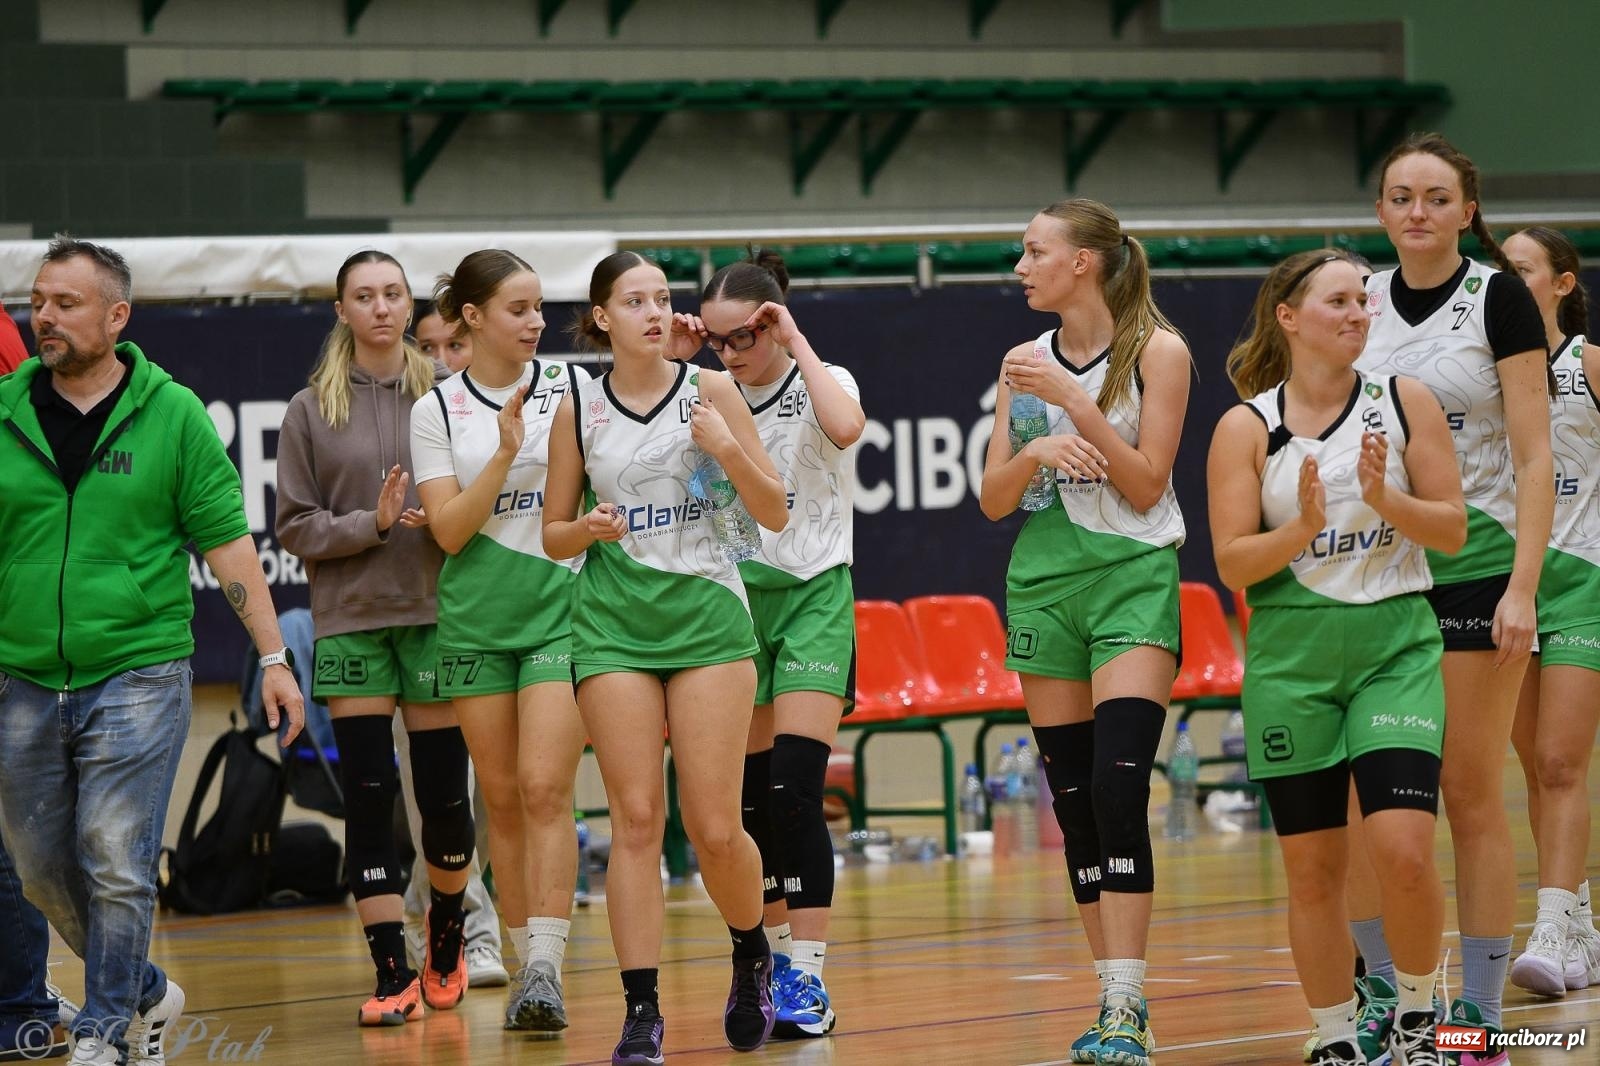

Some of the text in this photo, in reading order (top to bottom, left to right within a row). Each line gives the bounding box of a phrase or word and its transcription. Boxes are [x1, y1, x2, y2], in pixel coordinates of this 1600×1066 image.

[1451, 301, 1475, 331] 7
[852, 381, 998, 514] CIBÓ
[493, 489, 544, 515] Clav
[628, 497, 701, 533] Clavis
[1310, 521, 1396, 558] Clavis
[317, 654, 369, 685] 28
[442, 653, 484, 686] 77
[1262, 725, 1294, 762] 3
[370, 866, 387, 881] NBA
[1087, 865, 1102, 883] NB
[1115, 857, 1135, 874] NBA
